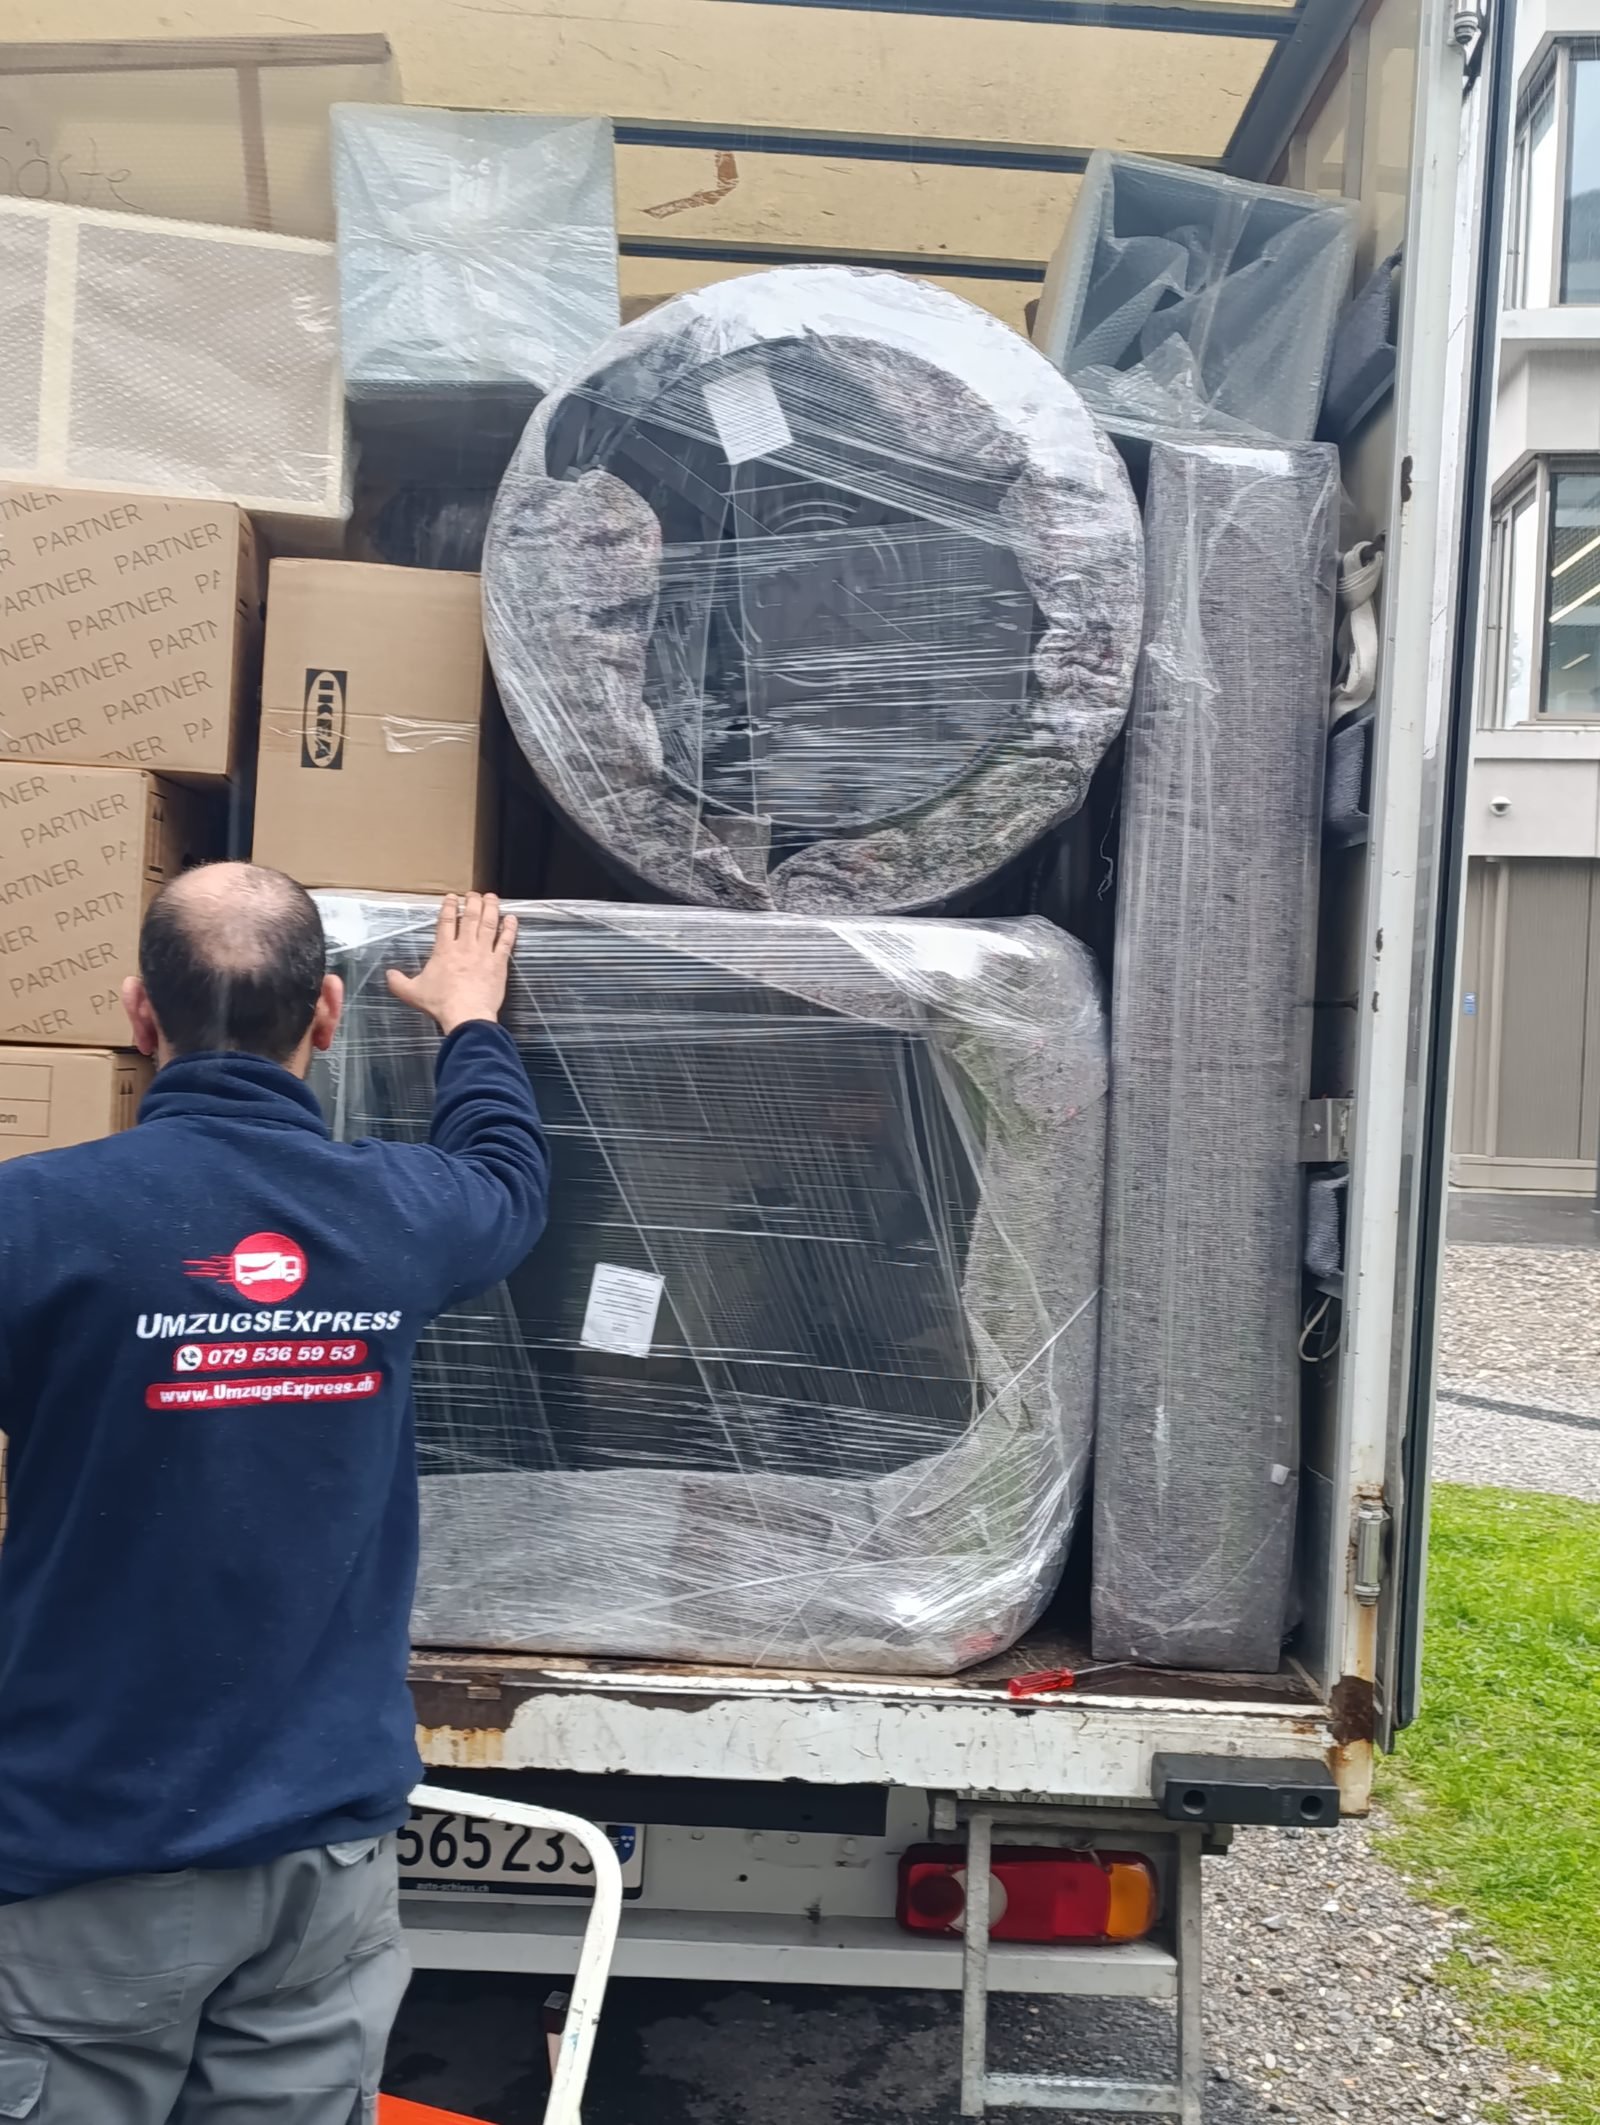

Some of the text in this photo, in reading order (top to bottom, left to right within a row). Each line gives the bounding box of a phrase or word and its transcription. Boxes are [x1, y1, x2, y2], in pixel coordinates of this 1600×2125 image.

[33, 503, 144, 556] PARTNER
[113, 522, 223, 575] PARTNER
[67, 586, 178, 640] PARTNER
[21, 651, 133, 706] PARTNER
[103, 670, 213, 725] PARTNER
[314, 680, 335, 760] IKEA
[21, 793, 129, 849] PARTNER
[9, 942, 119, 998] PARTNER
[207, 1344, 357, 1365] 079 536 59 53
[160, 1375, 375, 1401] www.UmzugsExpress.ch
